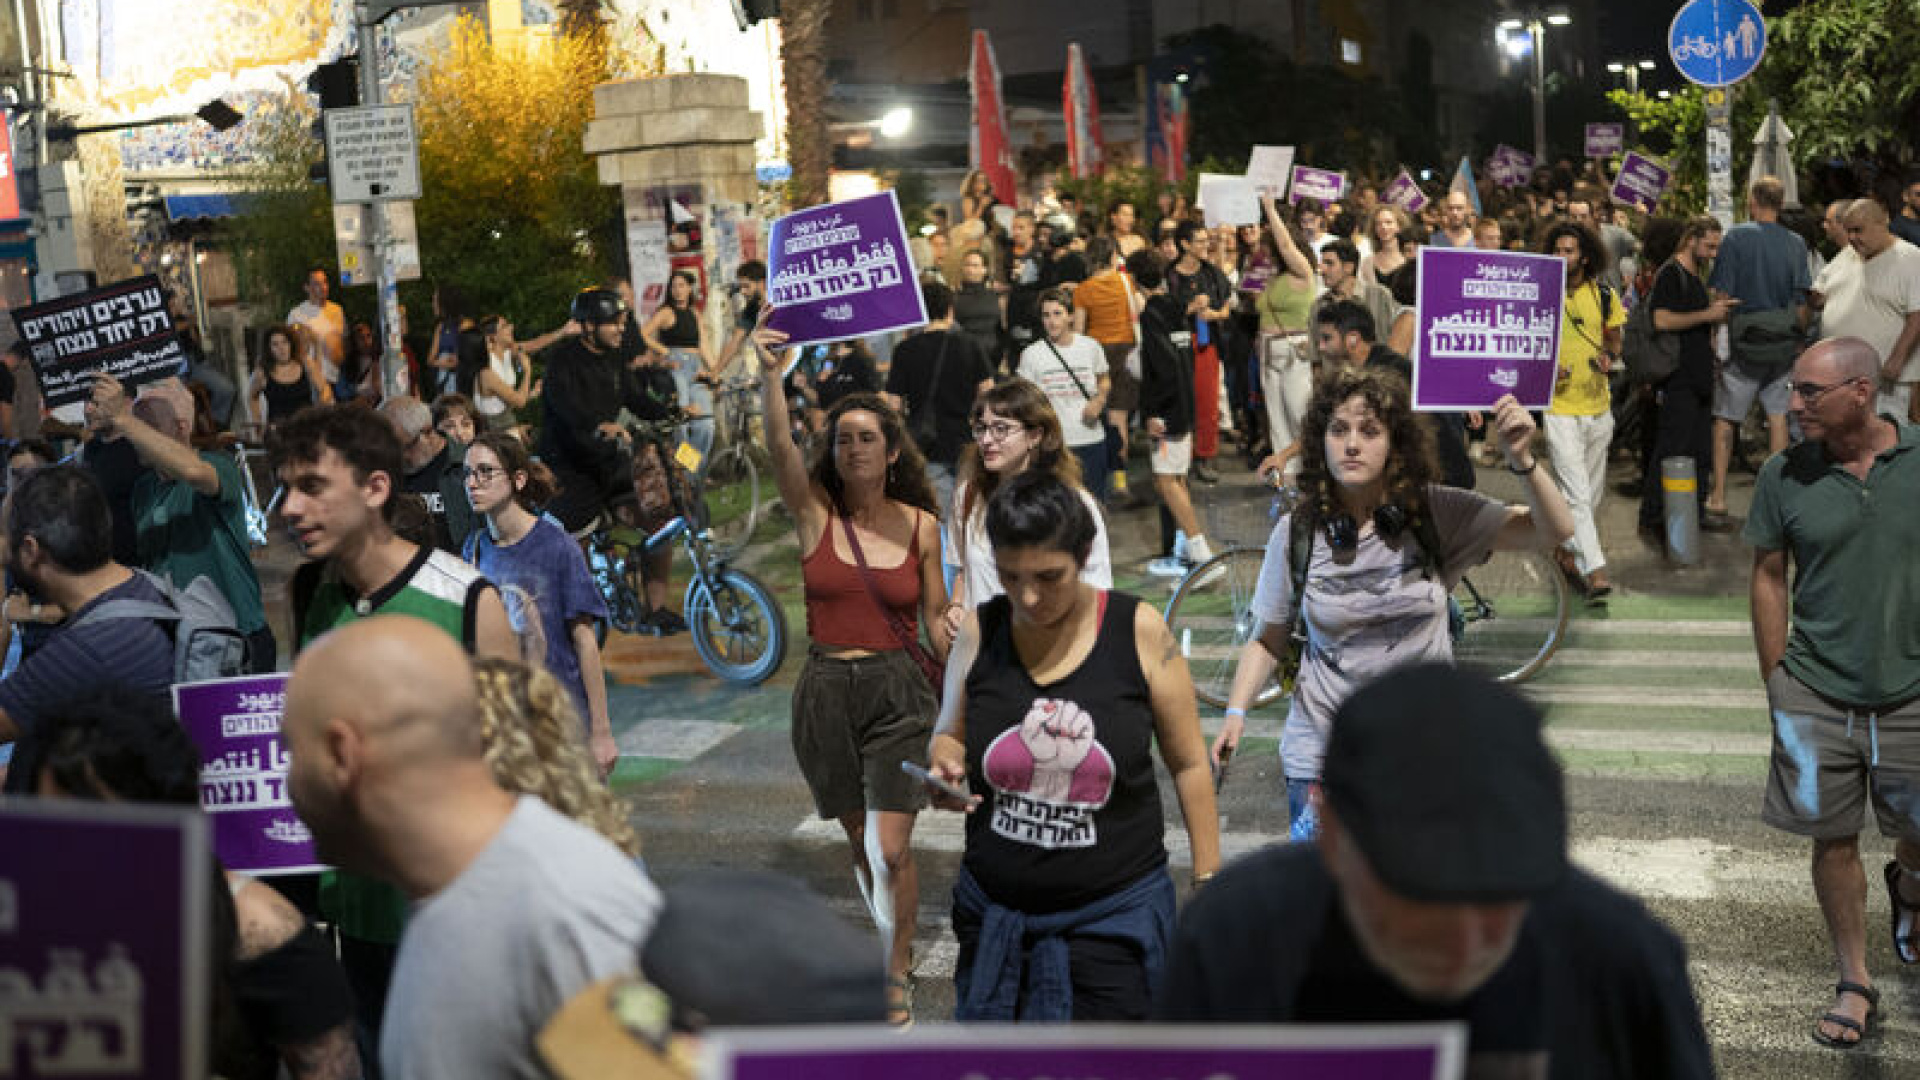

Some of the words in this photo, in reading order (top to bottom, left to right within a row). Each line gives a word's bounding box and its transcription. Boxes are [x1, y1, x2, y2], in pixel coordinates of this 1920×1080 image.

[852, 237, 896, 269] فقط
[814, 270, 866, 294] ביחד
[868, 265, 899, 289] רק
[91, 287, 162, 323] ערבים
[22, 306, 92, 341] ויהודים
[98, 318, 135, 344] יחד
[138, 310, 171, 337] רק
[1428, 309, 1491, 336] ننتصر
[54, 329, 99, 357] ננצח
[1435, 332, 1488, 352] ננצח
[203, 779, 257, 805] ננצח
